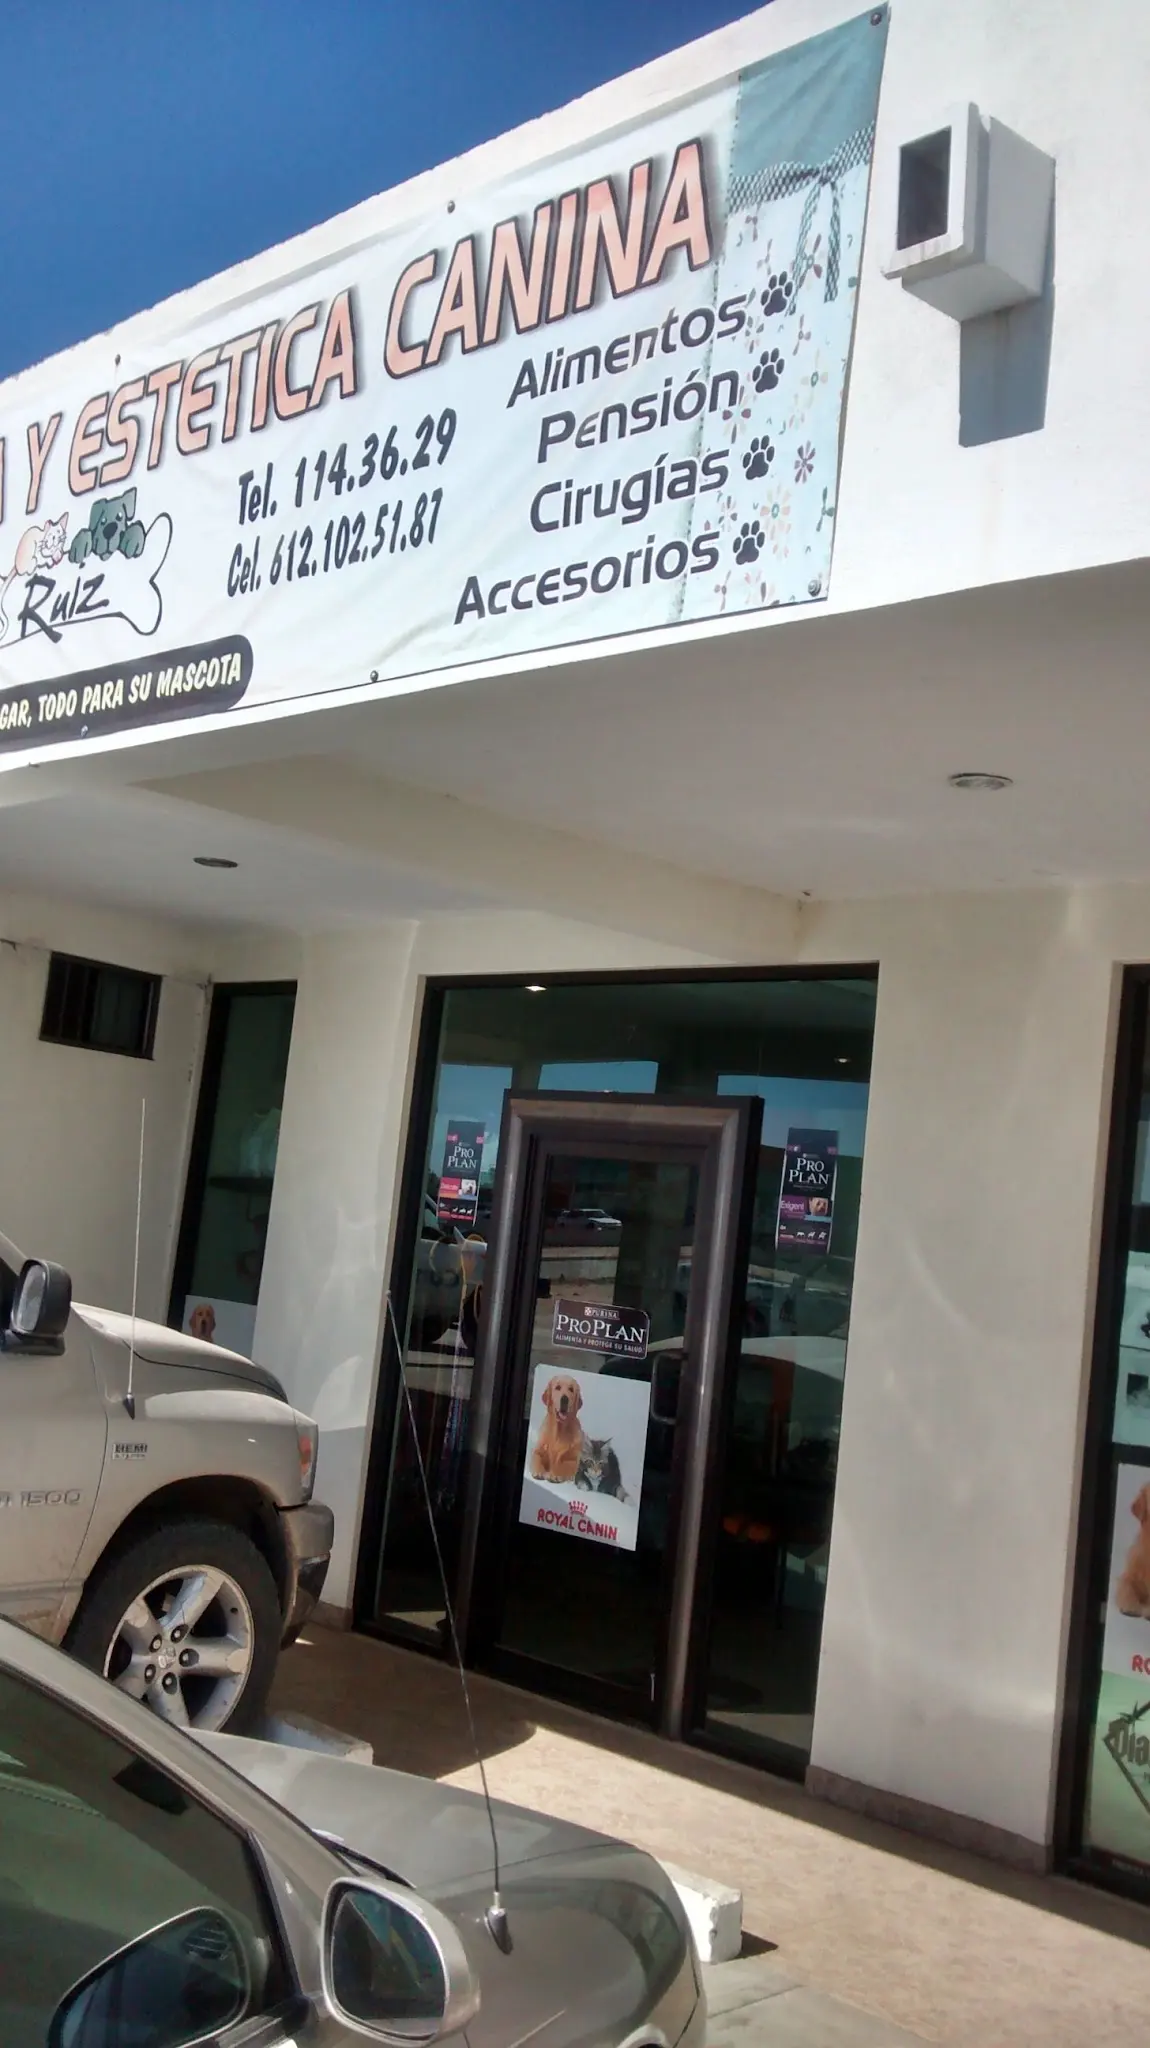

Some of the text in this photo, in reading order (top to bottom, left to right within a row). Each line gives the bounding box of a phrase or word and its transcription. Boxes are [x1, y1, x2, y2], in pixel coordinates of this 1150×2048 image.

[67, 285, 359, 496] ESTETICA
[383, 137, 713, 380] CANINA
[506, 294, 748, 409] Alimentos
[536, 367, 740, 464] Pensión
[238, 407, 457, 526] Tel. 114.36.29
[529, 447, 730, 534] Cirugías
[226, 487, 444, 598] Cel. 612.102.51.87
[453, 528, 721, 625] Accesorios
[17, 562, 110, 644] Ruiz
[38, 689, 78, 723] TODO
[81, 678, 124, 715] PARA
[128, 671, 153, 705] SU
[156, 652, 242, 699] MASCOTA
[447, 1155, 478, 1169] PLAN
[453, 1145, 475, 1159] PRO
[788, 1169, 830, 1185] PLAN
[796, 1157, 826, 1173] PRO
[536, 1507, 618, 1541] ROYAL CANIN
